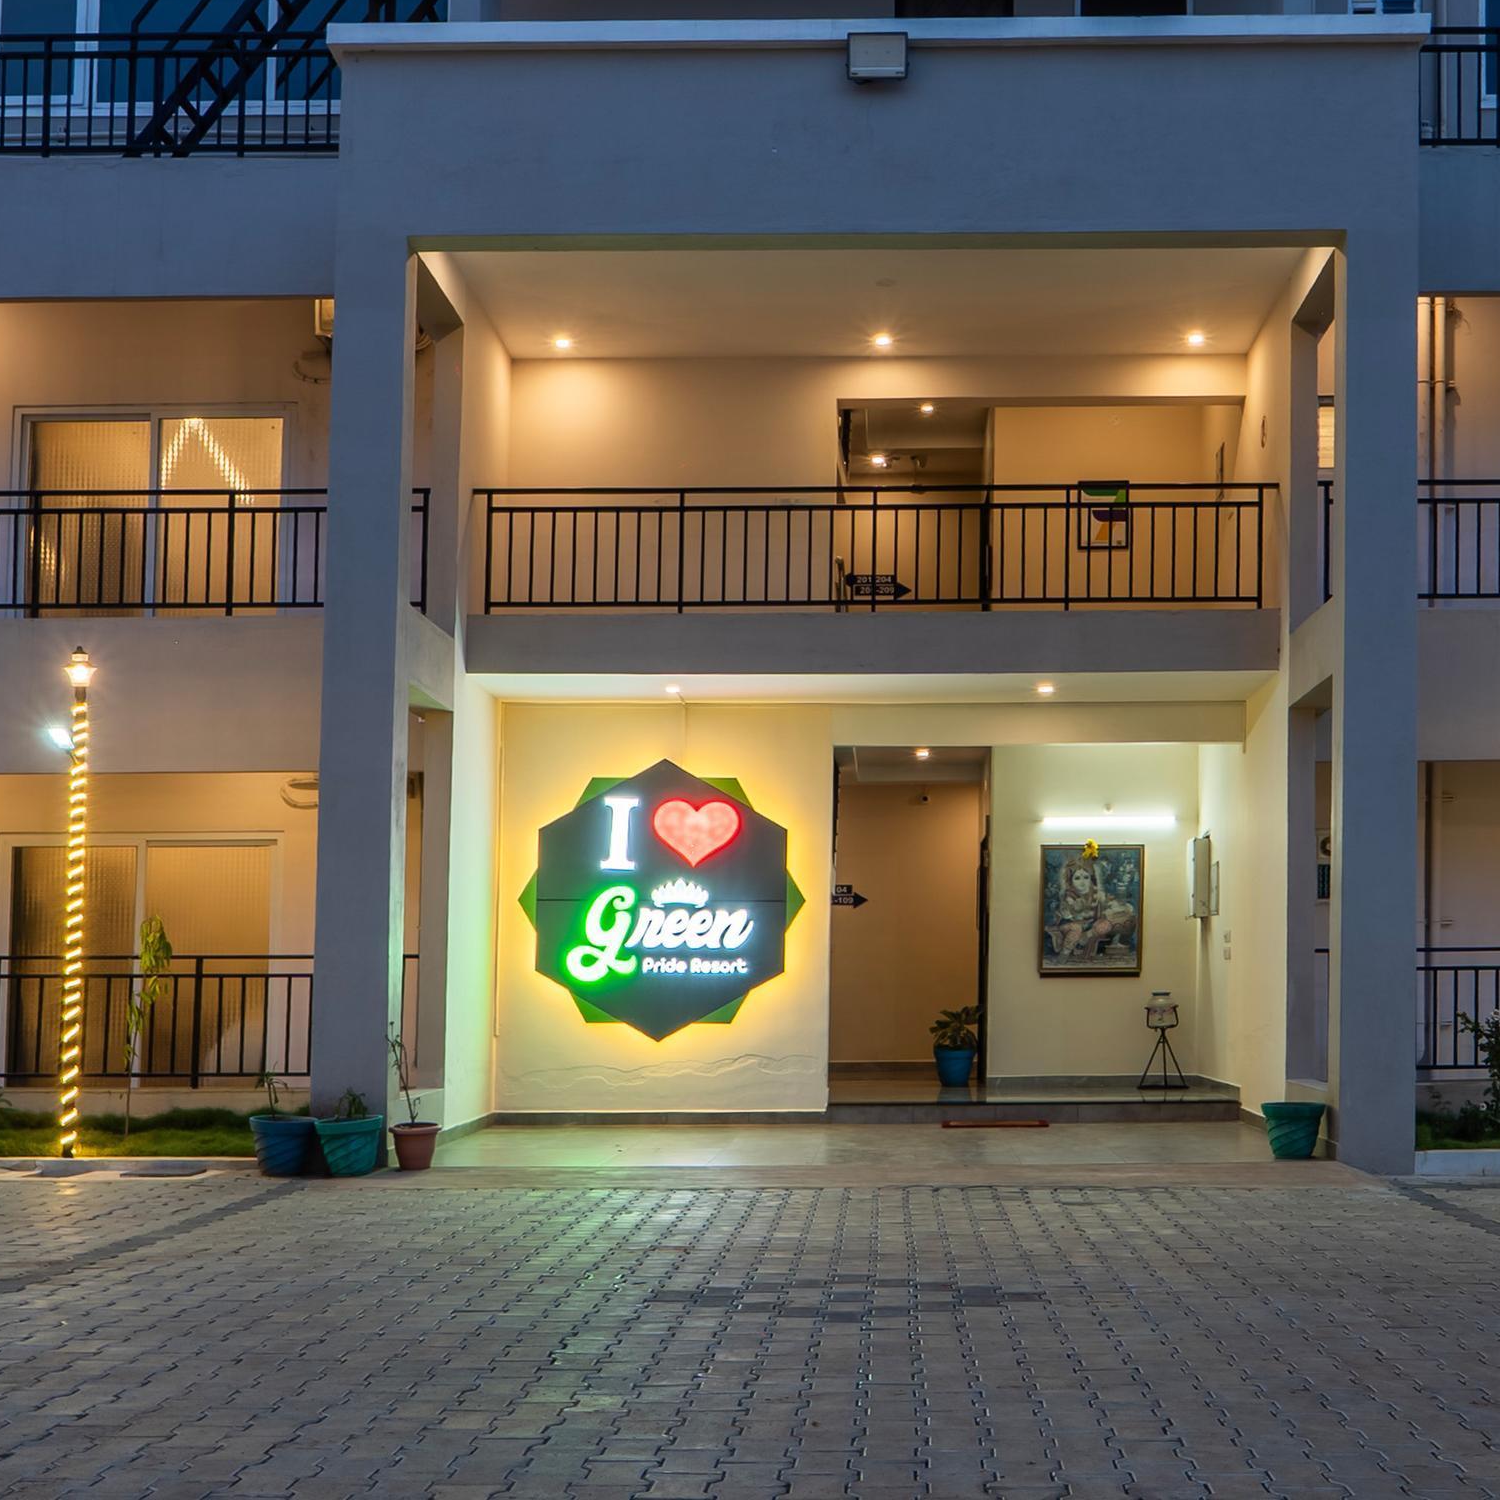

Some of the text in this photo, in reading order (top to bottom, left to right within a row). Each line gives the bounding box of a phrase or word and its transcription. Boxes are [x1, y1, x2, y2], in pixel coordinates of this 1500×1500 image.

[856, 576, 892, 584] 201204
[859, 586, 895, 594] 20-209
[600, 796, 639, 870] I
[566, 885, 754, 982] Green
[642, 956, 748, 974] Pride Resort
